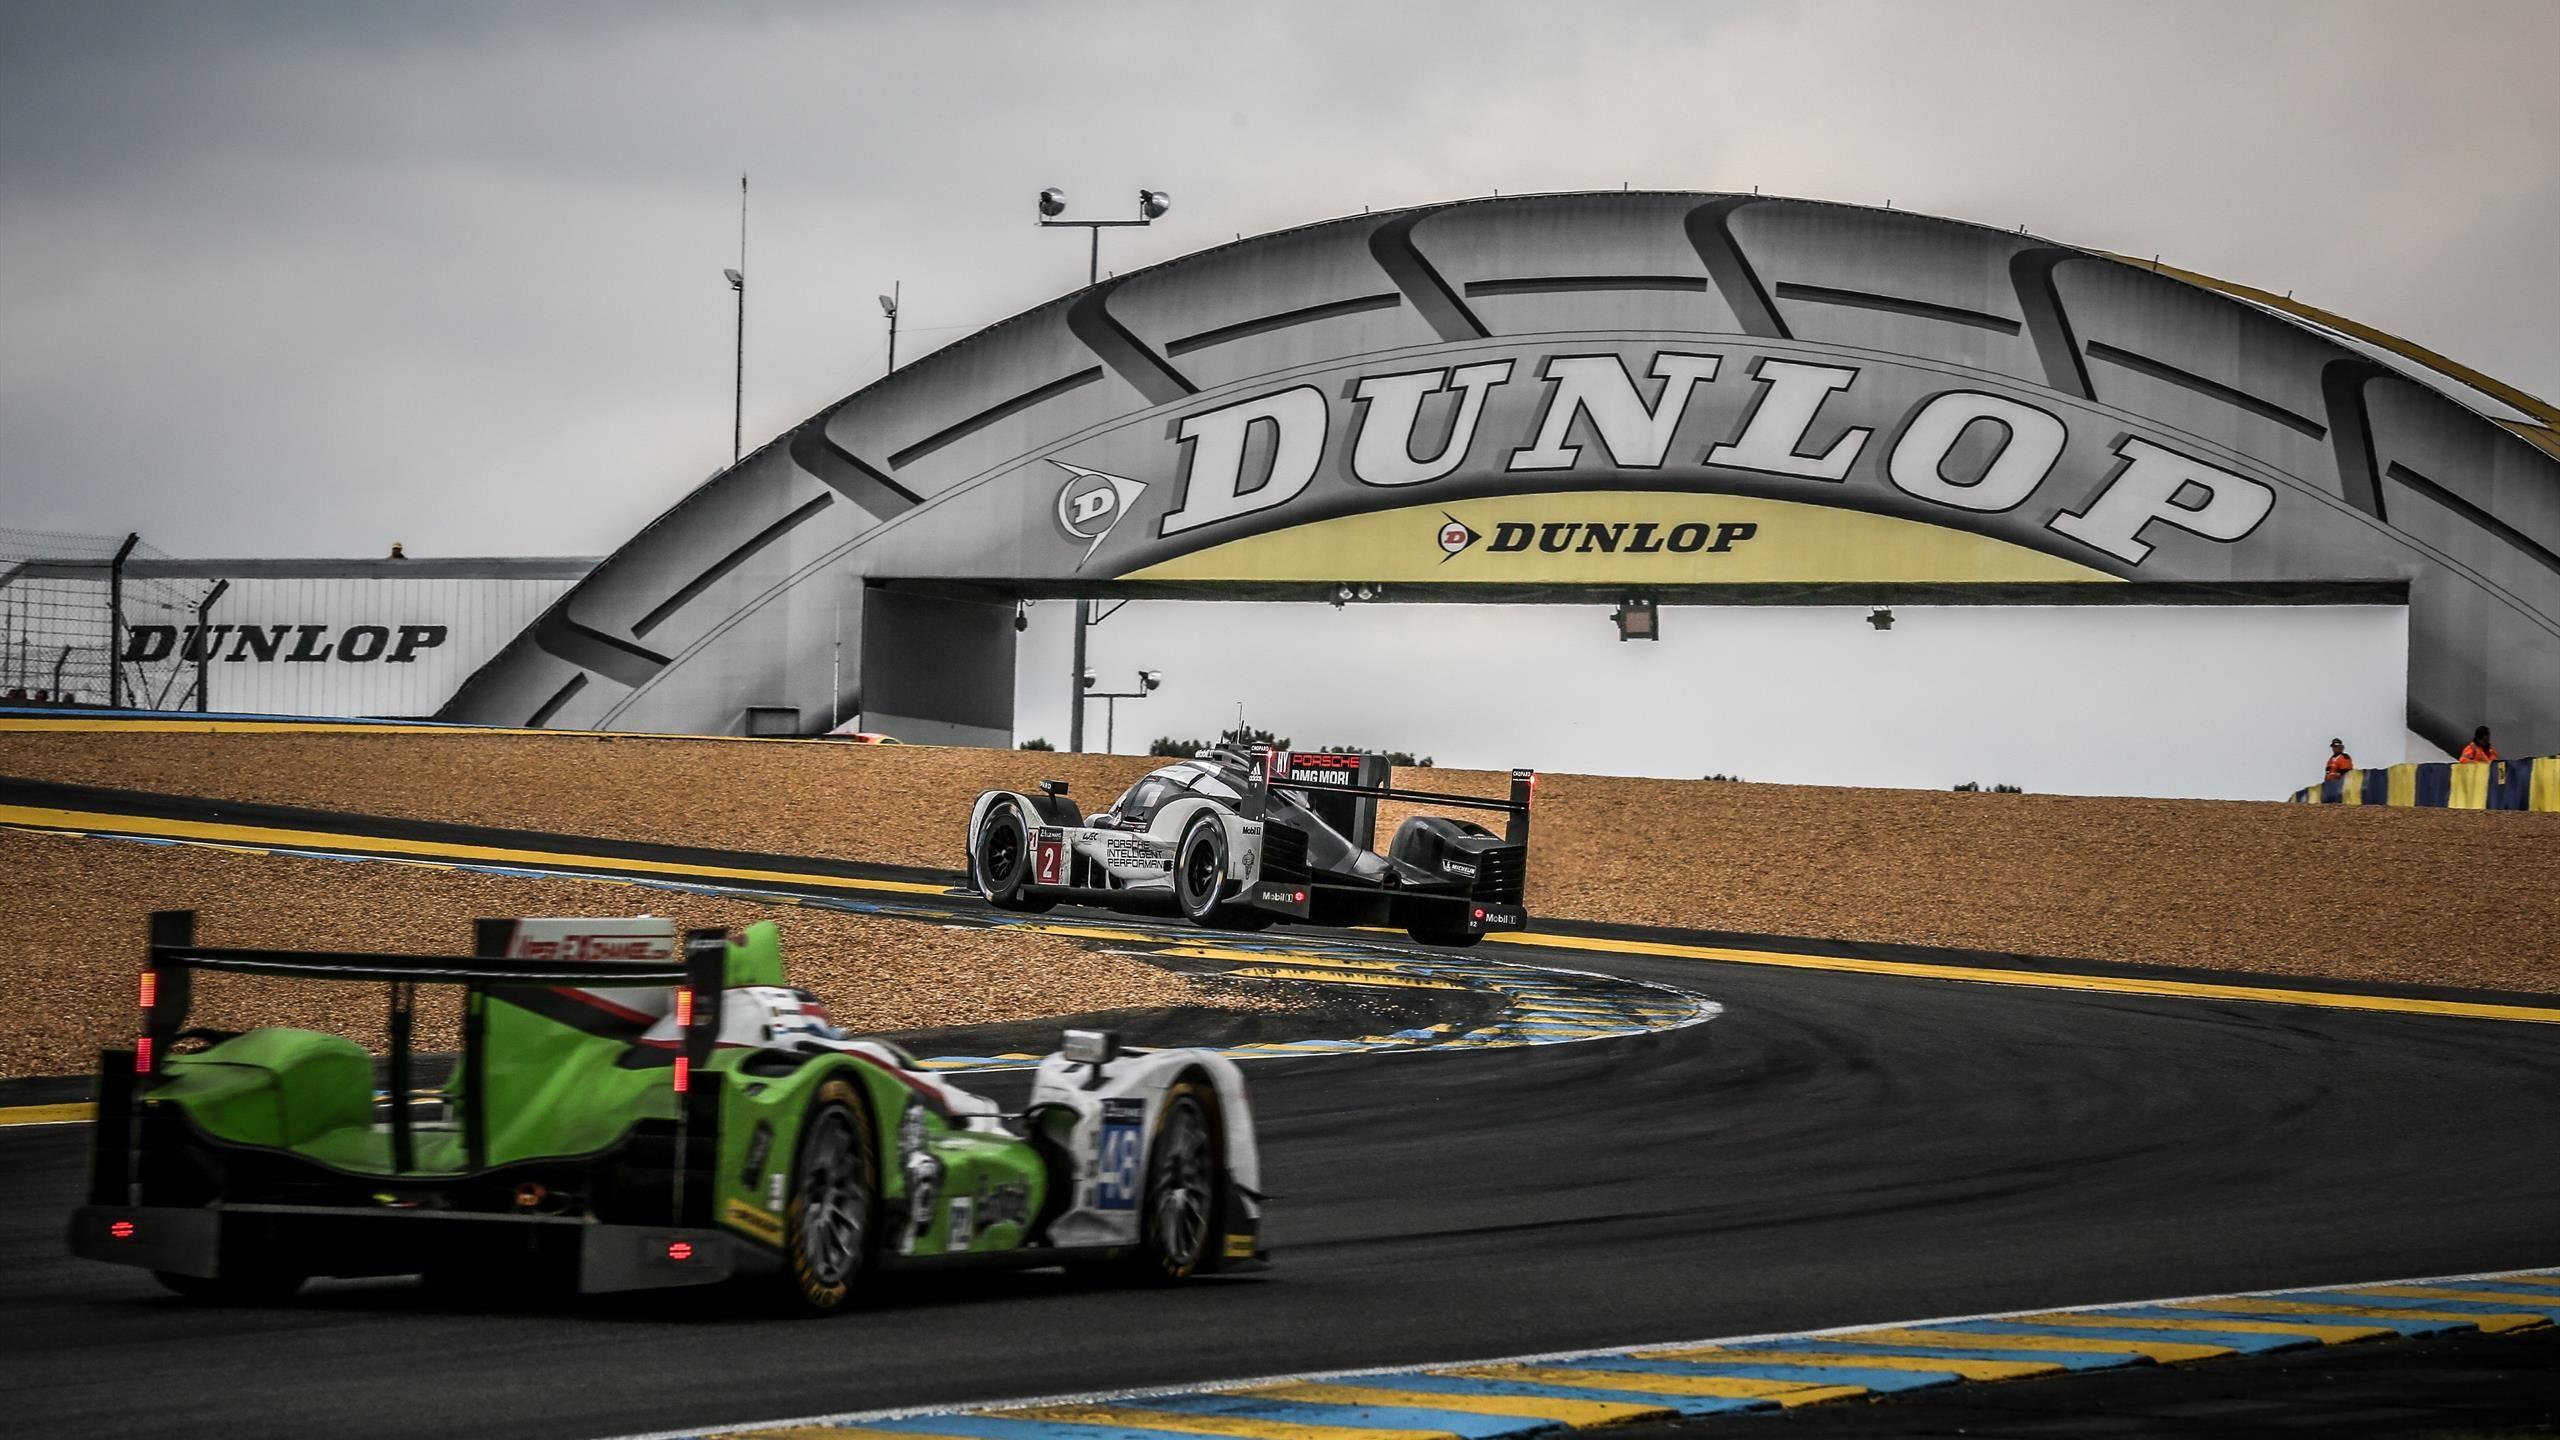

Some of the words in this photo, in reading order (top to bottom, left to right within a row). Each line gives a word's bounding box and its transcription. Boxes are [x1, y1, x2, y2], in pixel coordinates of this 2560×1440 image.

[1158, 350, 2276, 565] DUNLOP
[1486, 522, 1758, 553] DUNLOP
[121, 624, 448, 663] DUNLOP
[1292, 754, 1361, 769] PORSCHE
[1291, 769, 1319, 783] DMG
[1320, 771, 1350, 786] MORI
[1242, 826, 1257, 835] Mobil
[1107, 839, 1150, 849] PORSCHE
[1107, 849, 1163, 859] INTELLIGENT
[1042, 847, 1054, 878] 2
[1107, 859, 1173, 870] PERFORMAN
[1451, 863, 1476, 874] MICHELIN
[1262, 891, 1285, 902] Mobil
[1485, 913, 1508, 924] Mobil
